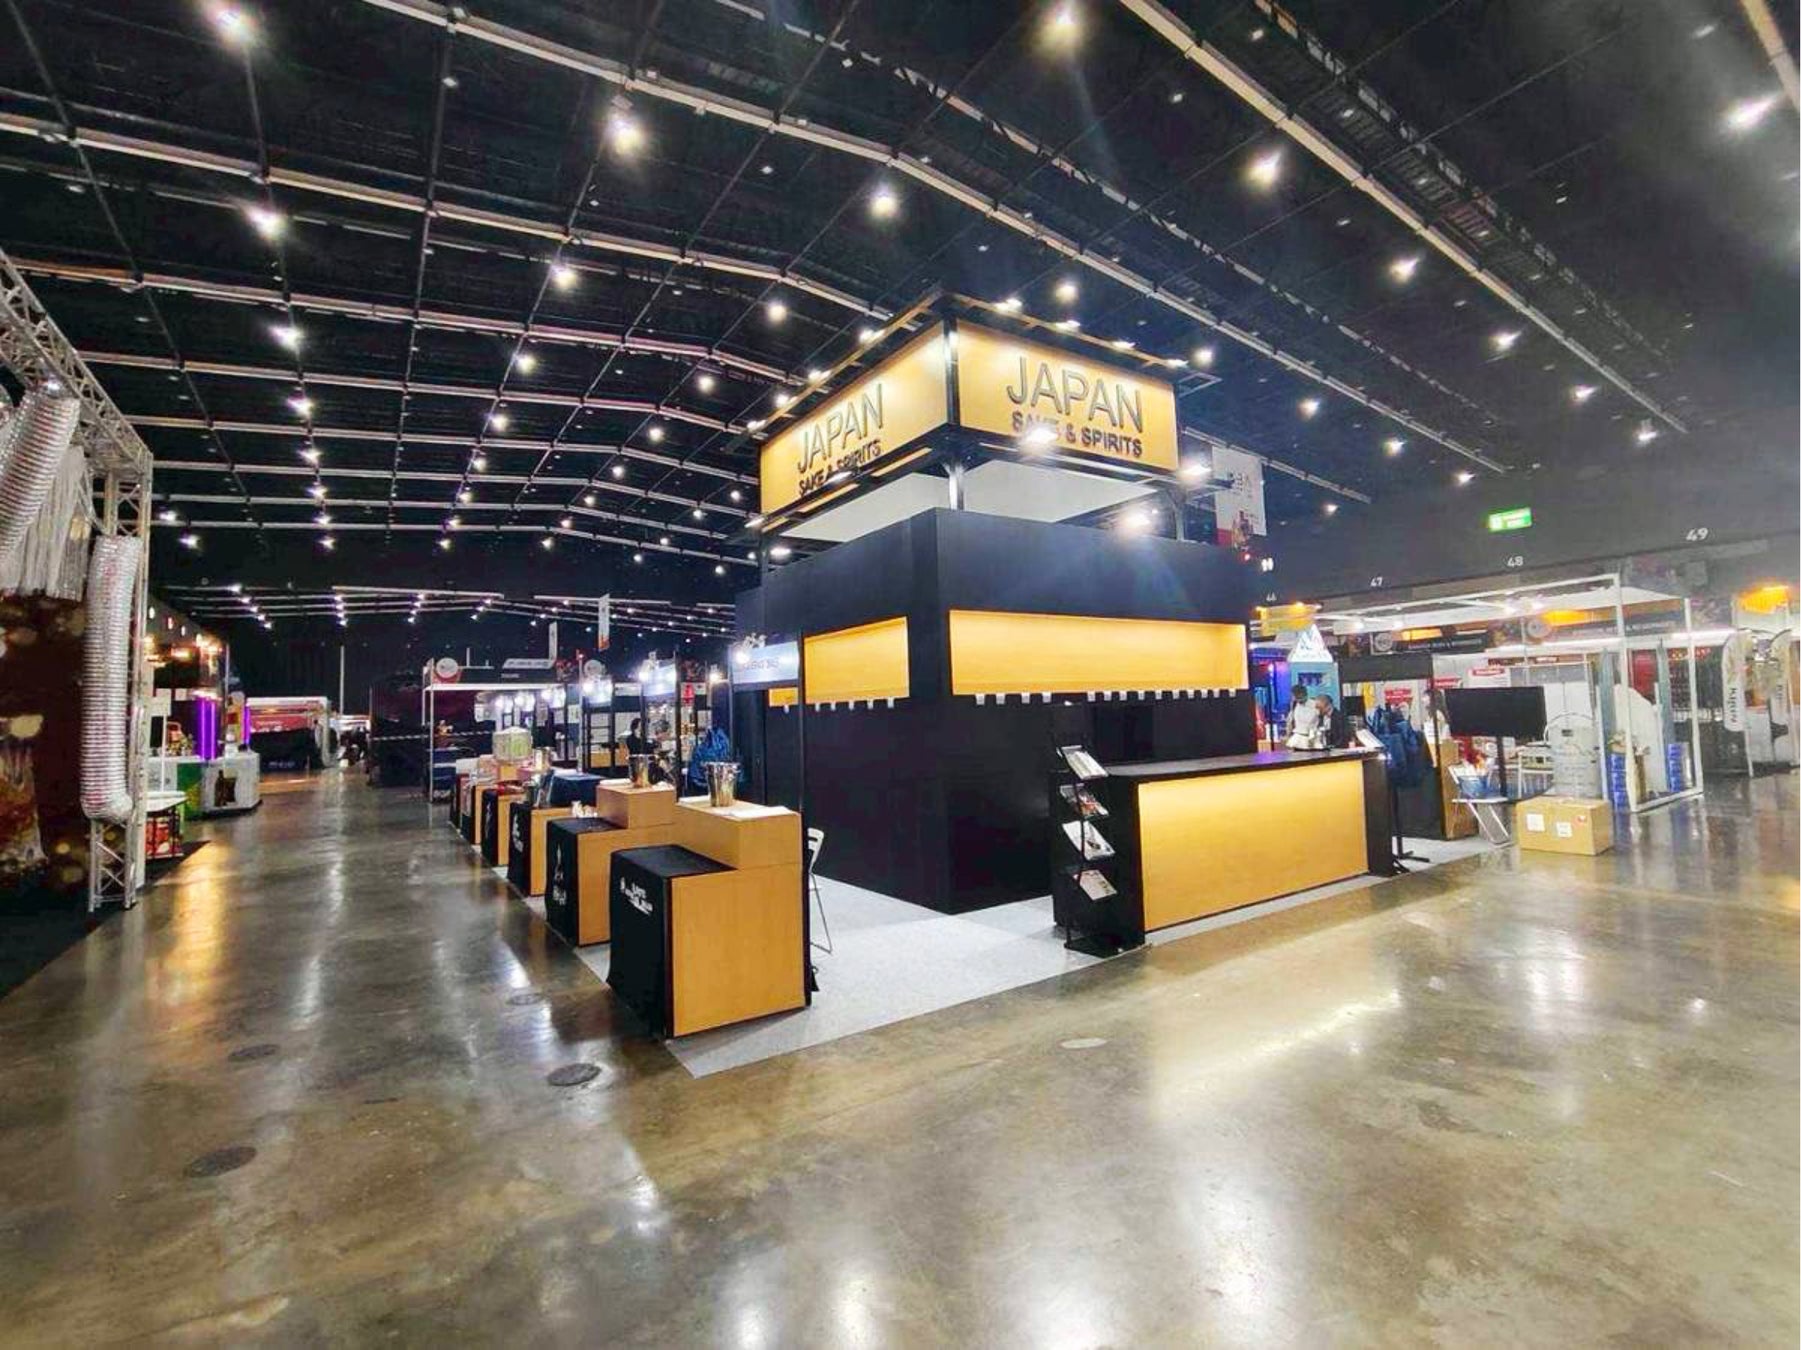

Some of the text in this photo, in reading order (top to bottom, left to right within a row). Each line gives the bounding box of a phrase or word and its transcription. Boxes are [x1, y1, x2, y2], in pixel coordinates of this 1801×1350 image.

[1006, 356, 1143, 433] JAPAN
[797, 383, 883, 474] JAPAN
[1066, 422, 1076, 444] &
[1081, 426, 1142, 458] SPIRITS
[1686, 528, 1709, 541] 49
[1507, 555, 1524, 568] 48
[1370, 577, 1383, 587] 47
